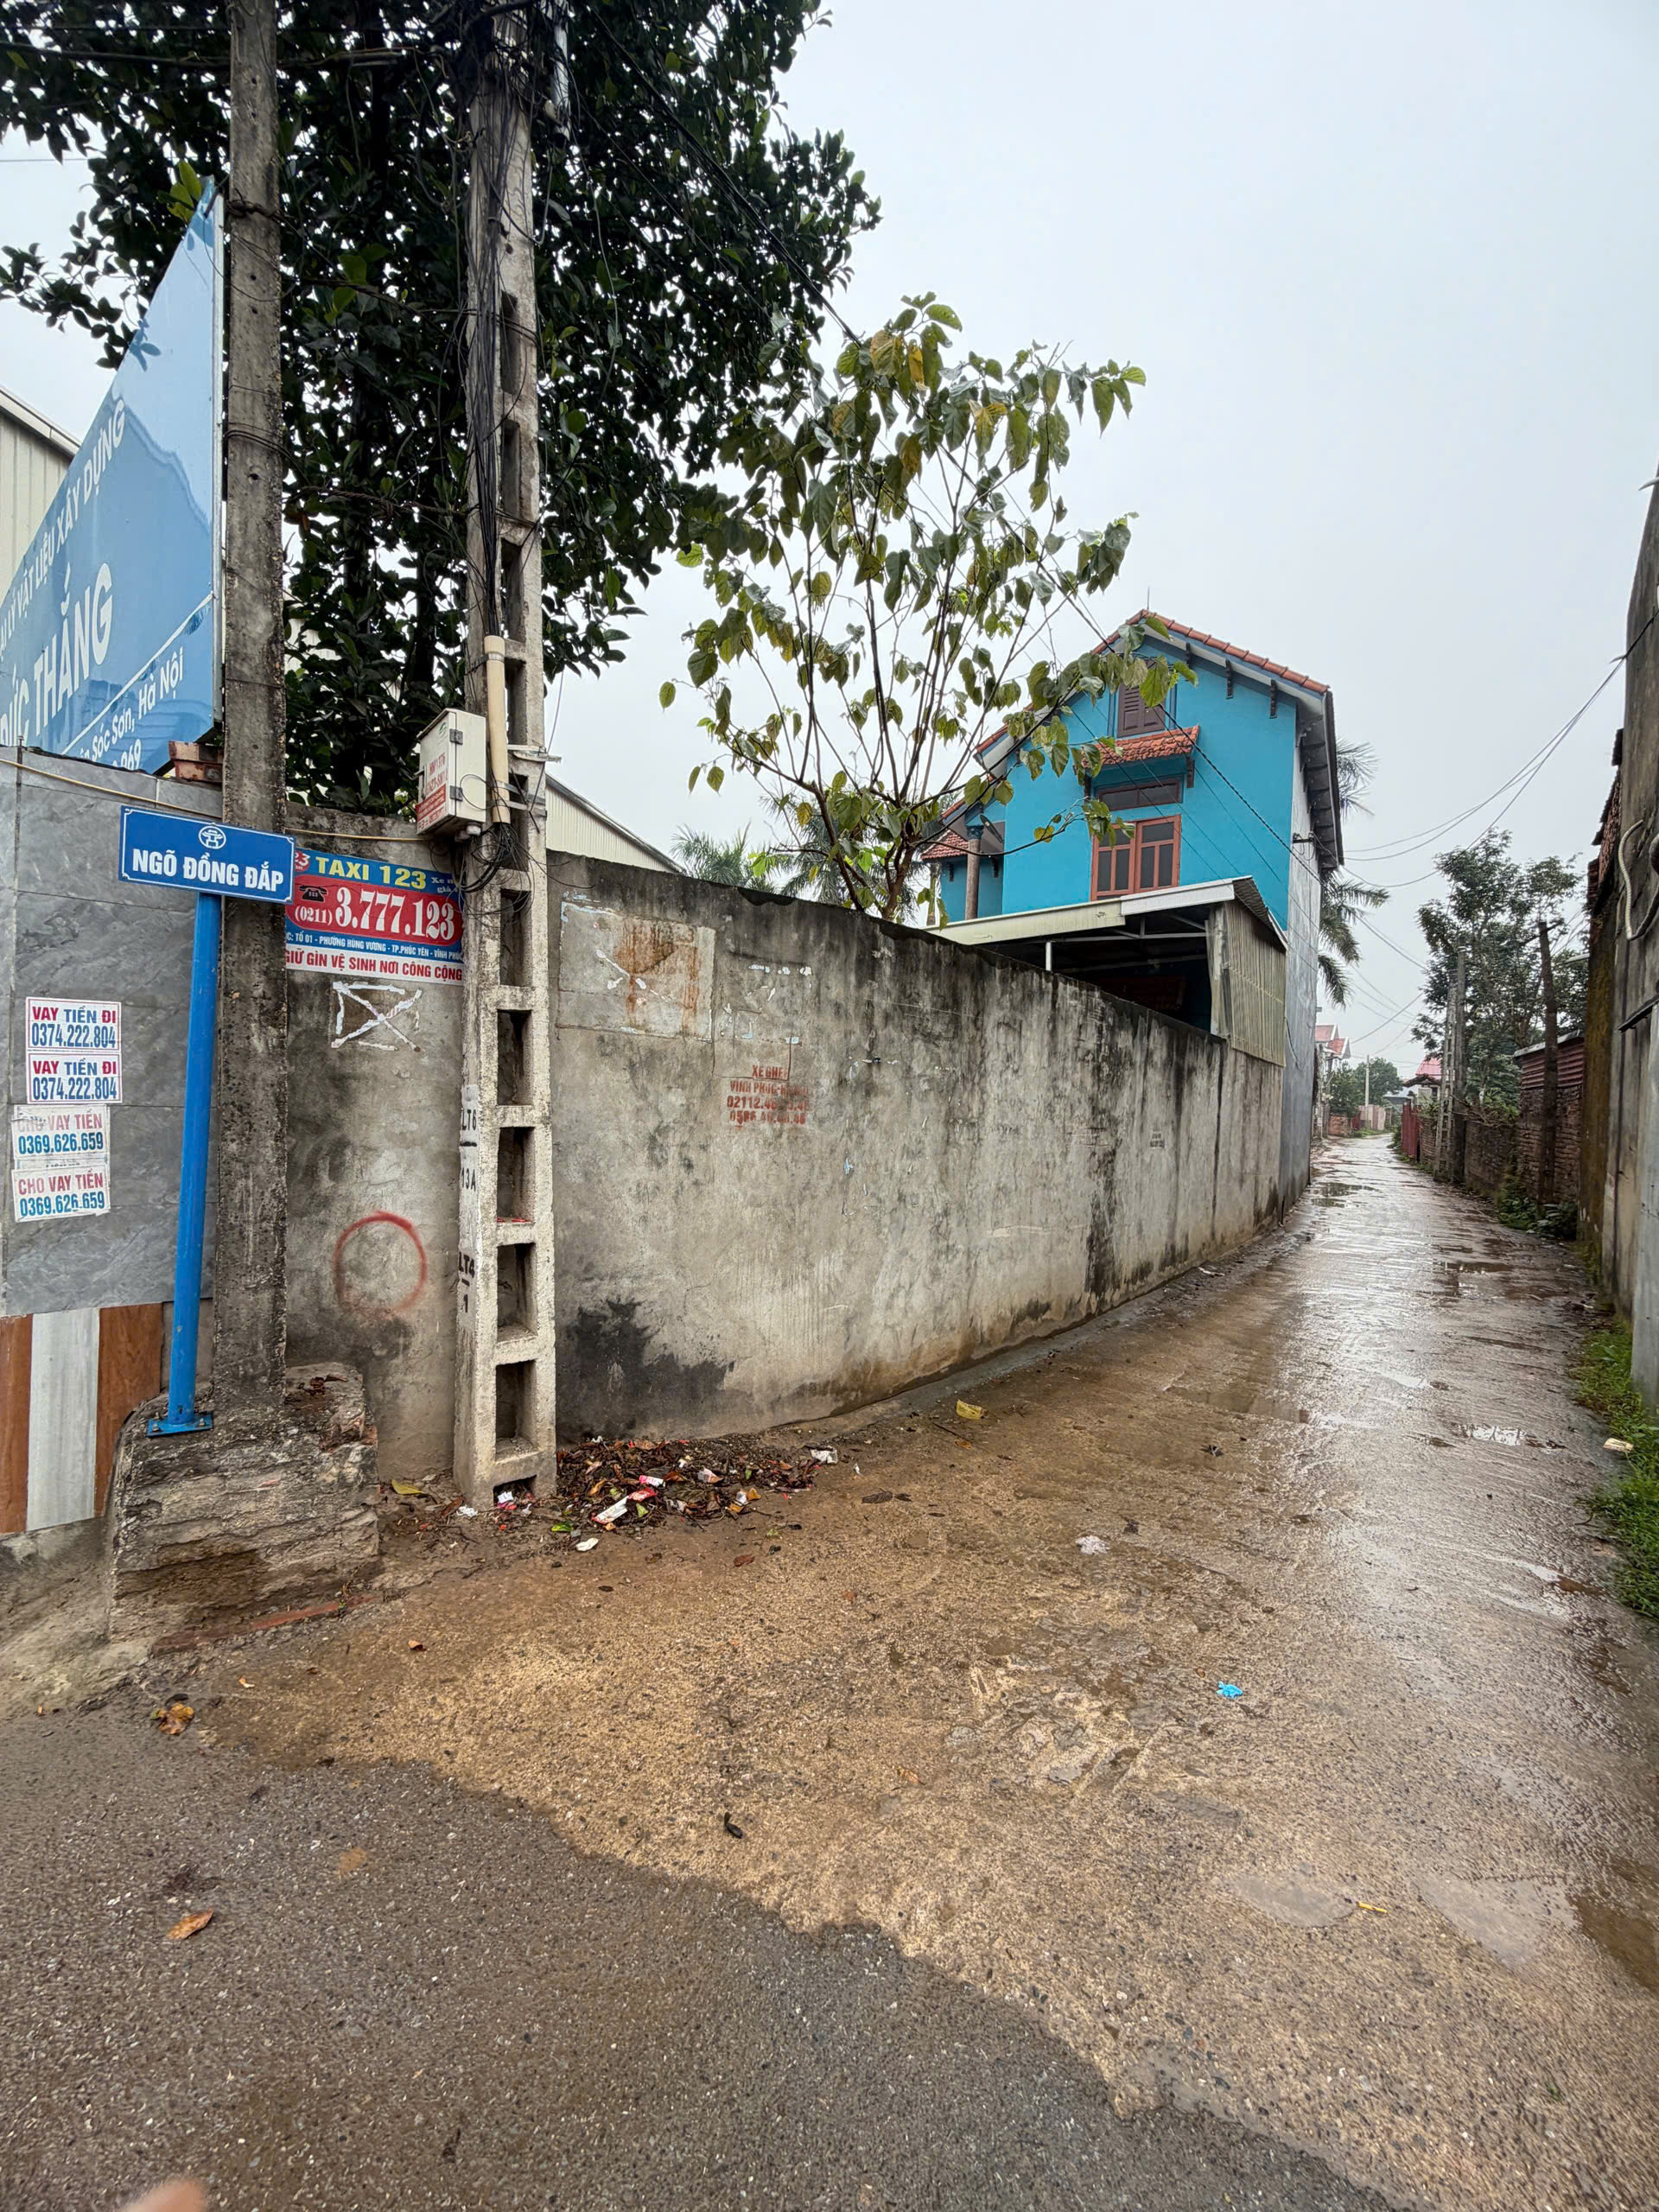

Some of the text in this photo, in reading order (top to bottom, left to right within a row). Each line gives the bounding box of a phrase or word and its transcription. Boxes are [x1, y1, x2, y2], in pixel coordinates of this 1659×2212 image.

[17, 566, 34, 618] VẬT
[35, 526, 55, 589] LIỆU
[56, 477, 80, 553] XÂY
[84, 399, 125, 505] DỰNG
[34, 562, 112, 736] THẮNG
[92, 646, 183, 762] Sóc Sơn, Hà Nội
[132, 849, 283, 893] NGÕ ĐỒNG ĐẮP
[315, 856, 426, 889] TAXI 123
[295, 887, 455, 940] (0211) 3.777.123
[304, 934, 313, 944] 01
[365, 941, 386, 951] VƯƠNG
[391, 944, 416, 956] TP.PHÚC
[417, 946, 429, 957] YÊN
[285, 947, 462, 982] GIỮ GÌN VỆ SINH NƠI CÔNG CỘNG
[32, 1006, 59, 1021] VAY
[101, 1010, 116, 1023] ĐI
[31, 1022, 116, 1048] 0374.222.804
[33, 1060, 60, 1075] VAY
[102, 1061, 117, 1075] ĐI
[753, 1065, 763, 1077] XE
[33, 1077, 117, 1100] 0374.222.804
[48, 1114, 70, 1131] VAY
[461, 1109, 476, 1131] LT6
[18, 1131, 104, 1154] 0369.626.659
[18, 1178, 44, 1195] CHO
[48, 1174, 71, 1192] VAY
[461, 1166, 476, 1192] 13A
[20, 1191, 105, 1217] 0369.626.659
